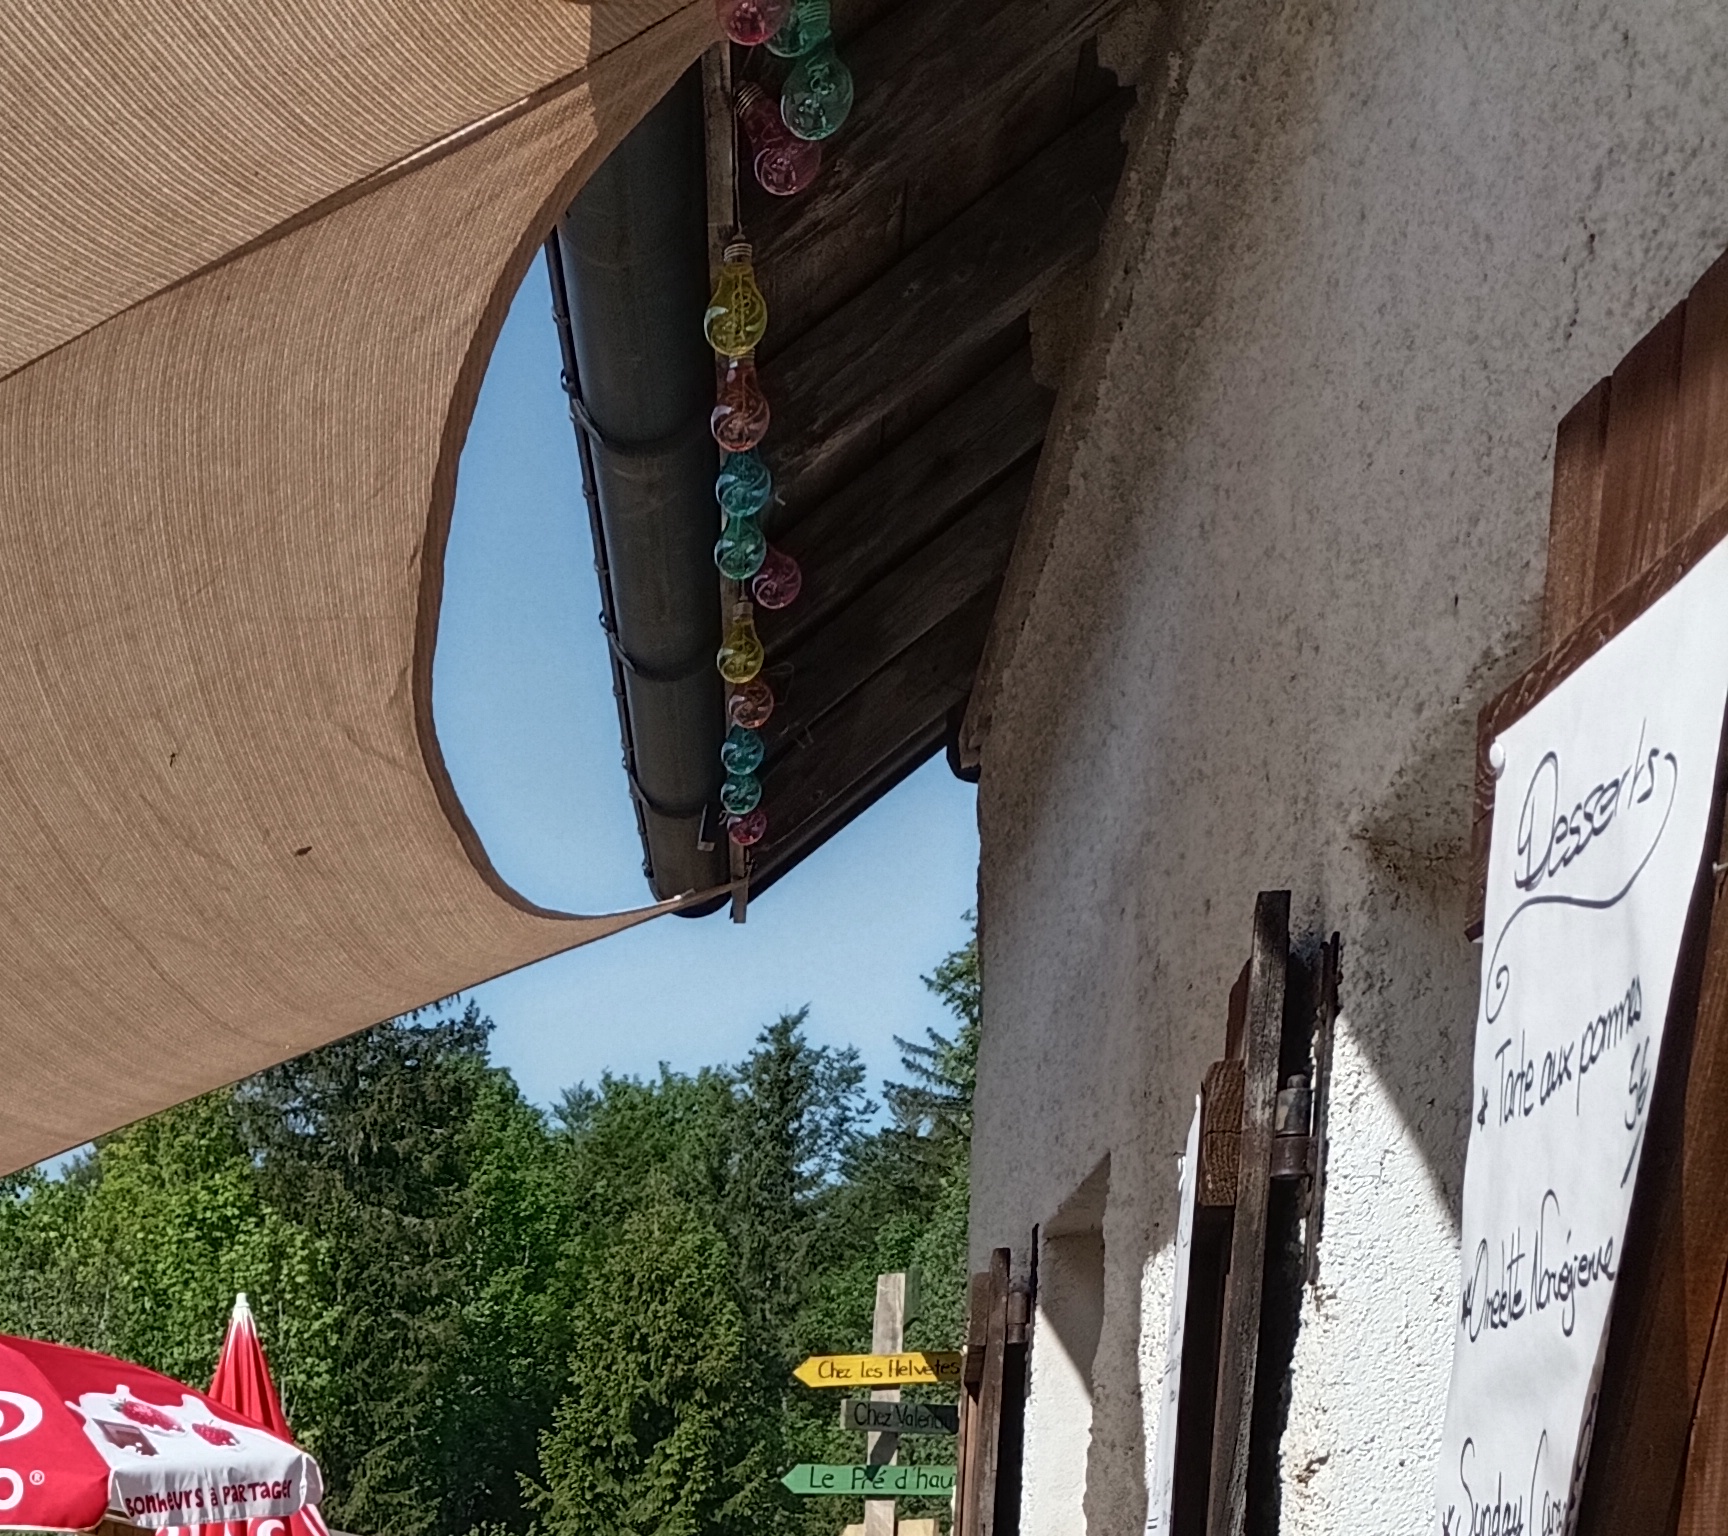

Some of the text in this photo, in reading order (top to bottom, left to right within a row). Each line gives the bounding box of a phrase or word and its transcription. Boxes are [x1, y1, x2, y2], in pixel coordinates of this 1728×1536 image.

[1515, 717, 1660, 891] Desserts
[1495, 974, 1643, 1128] Tarte aux pommes
[817, 1359, 853, 1379] Chez
[853, 1402, 892, 1427] Chez
[810, 1466, 835, 1489] Le
[851, 1467, 887, 1490] Pré
